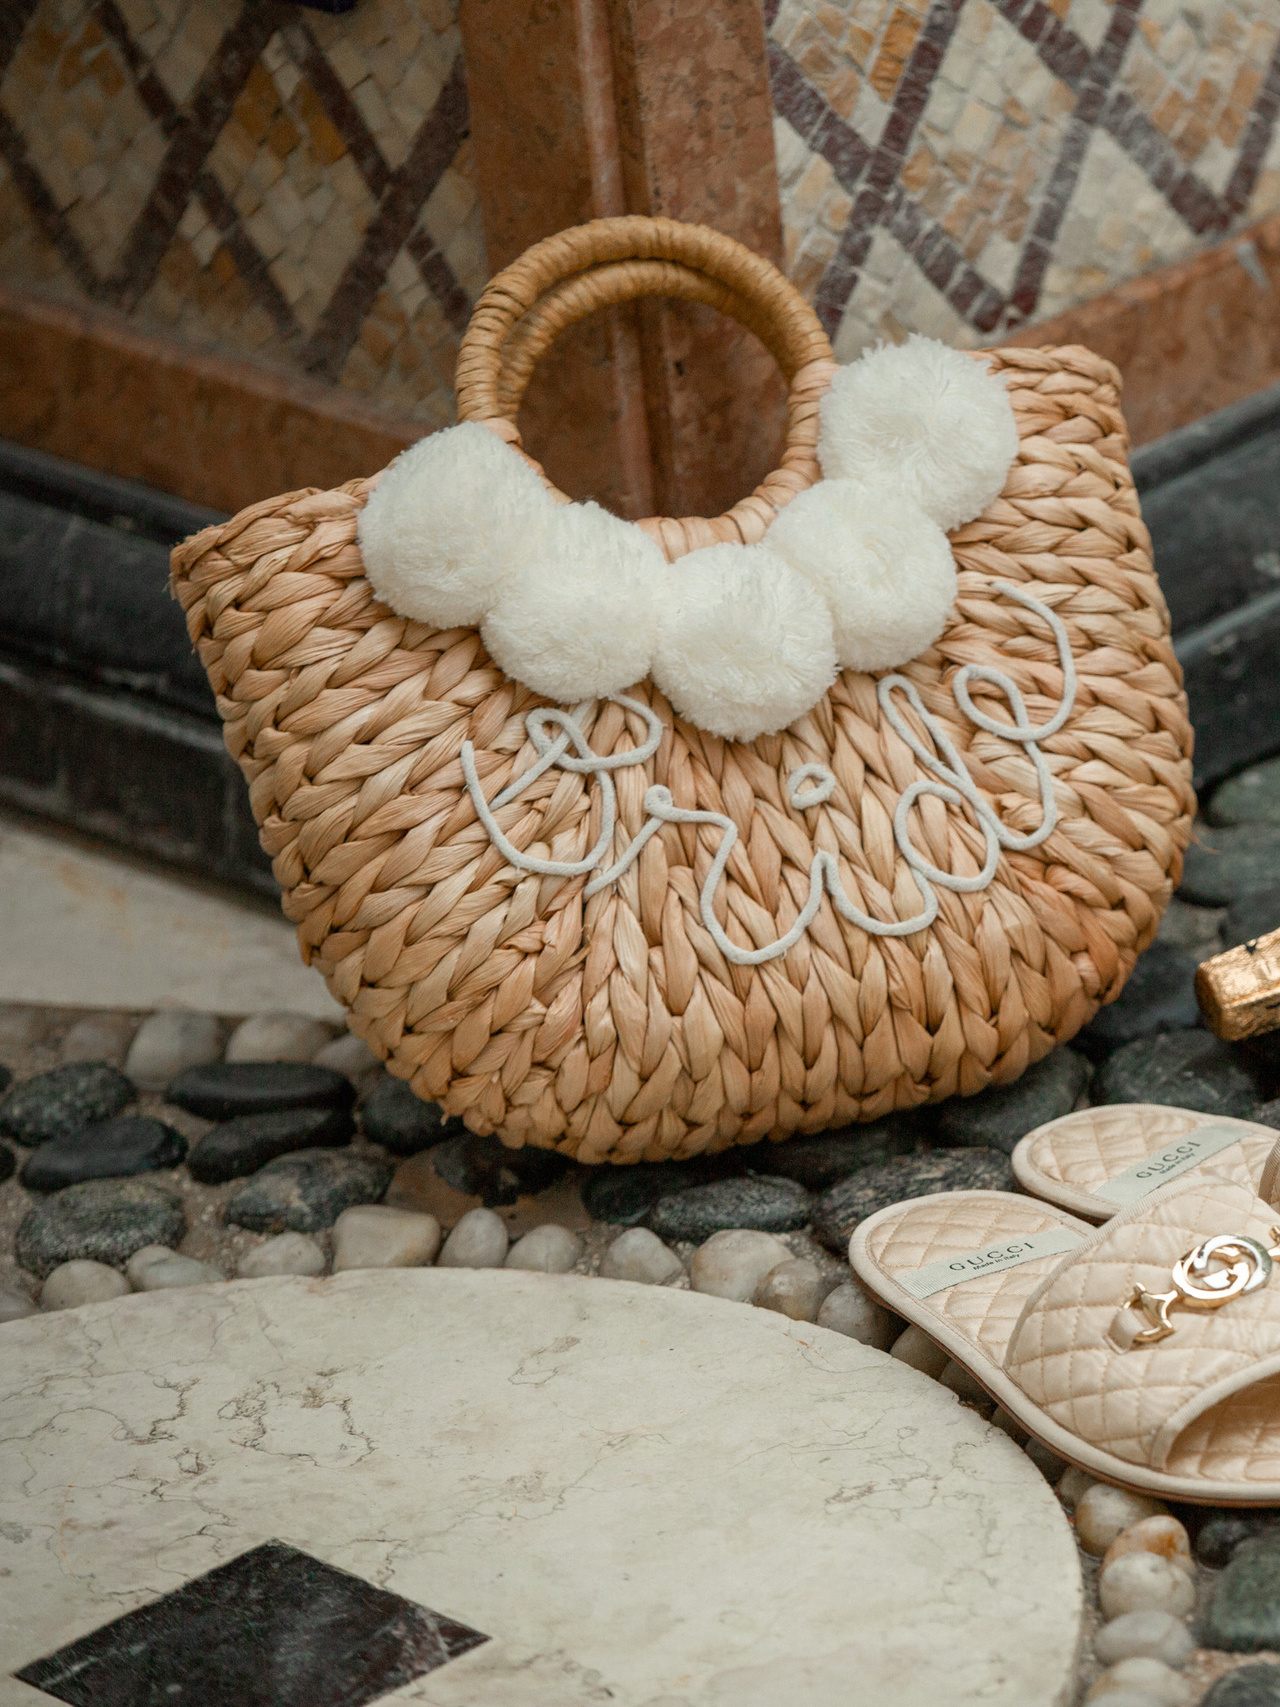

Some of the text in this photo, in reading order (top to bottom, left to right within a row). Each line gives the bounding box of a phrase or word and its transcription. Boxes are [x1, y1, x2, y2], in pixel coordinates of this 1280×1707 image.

[1136, 1141, 1202, 1179] GUCCI
[949, 1242, 1035, 1271] GUCCI
[972, 1260, 994, 1271] Made
[1003, 1253, 1020, 1262] Italy
